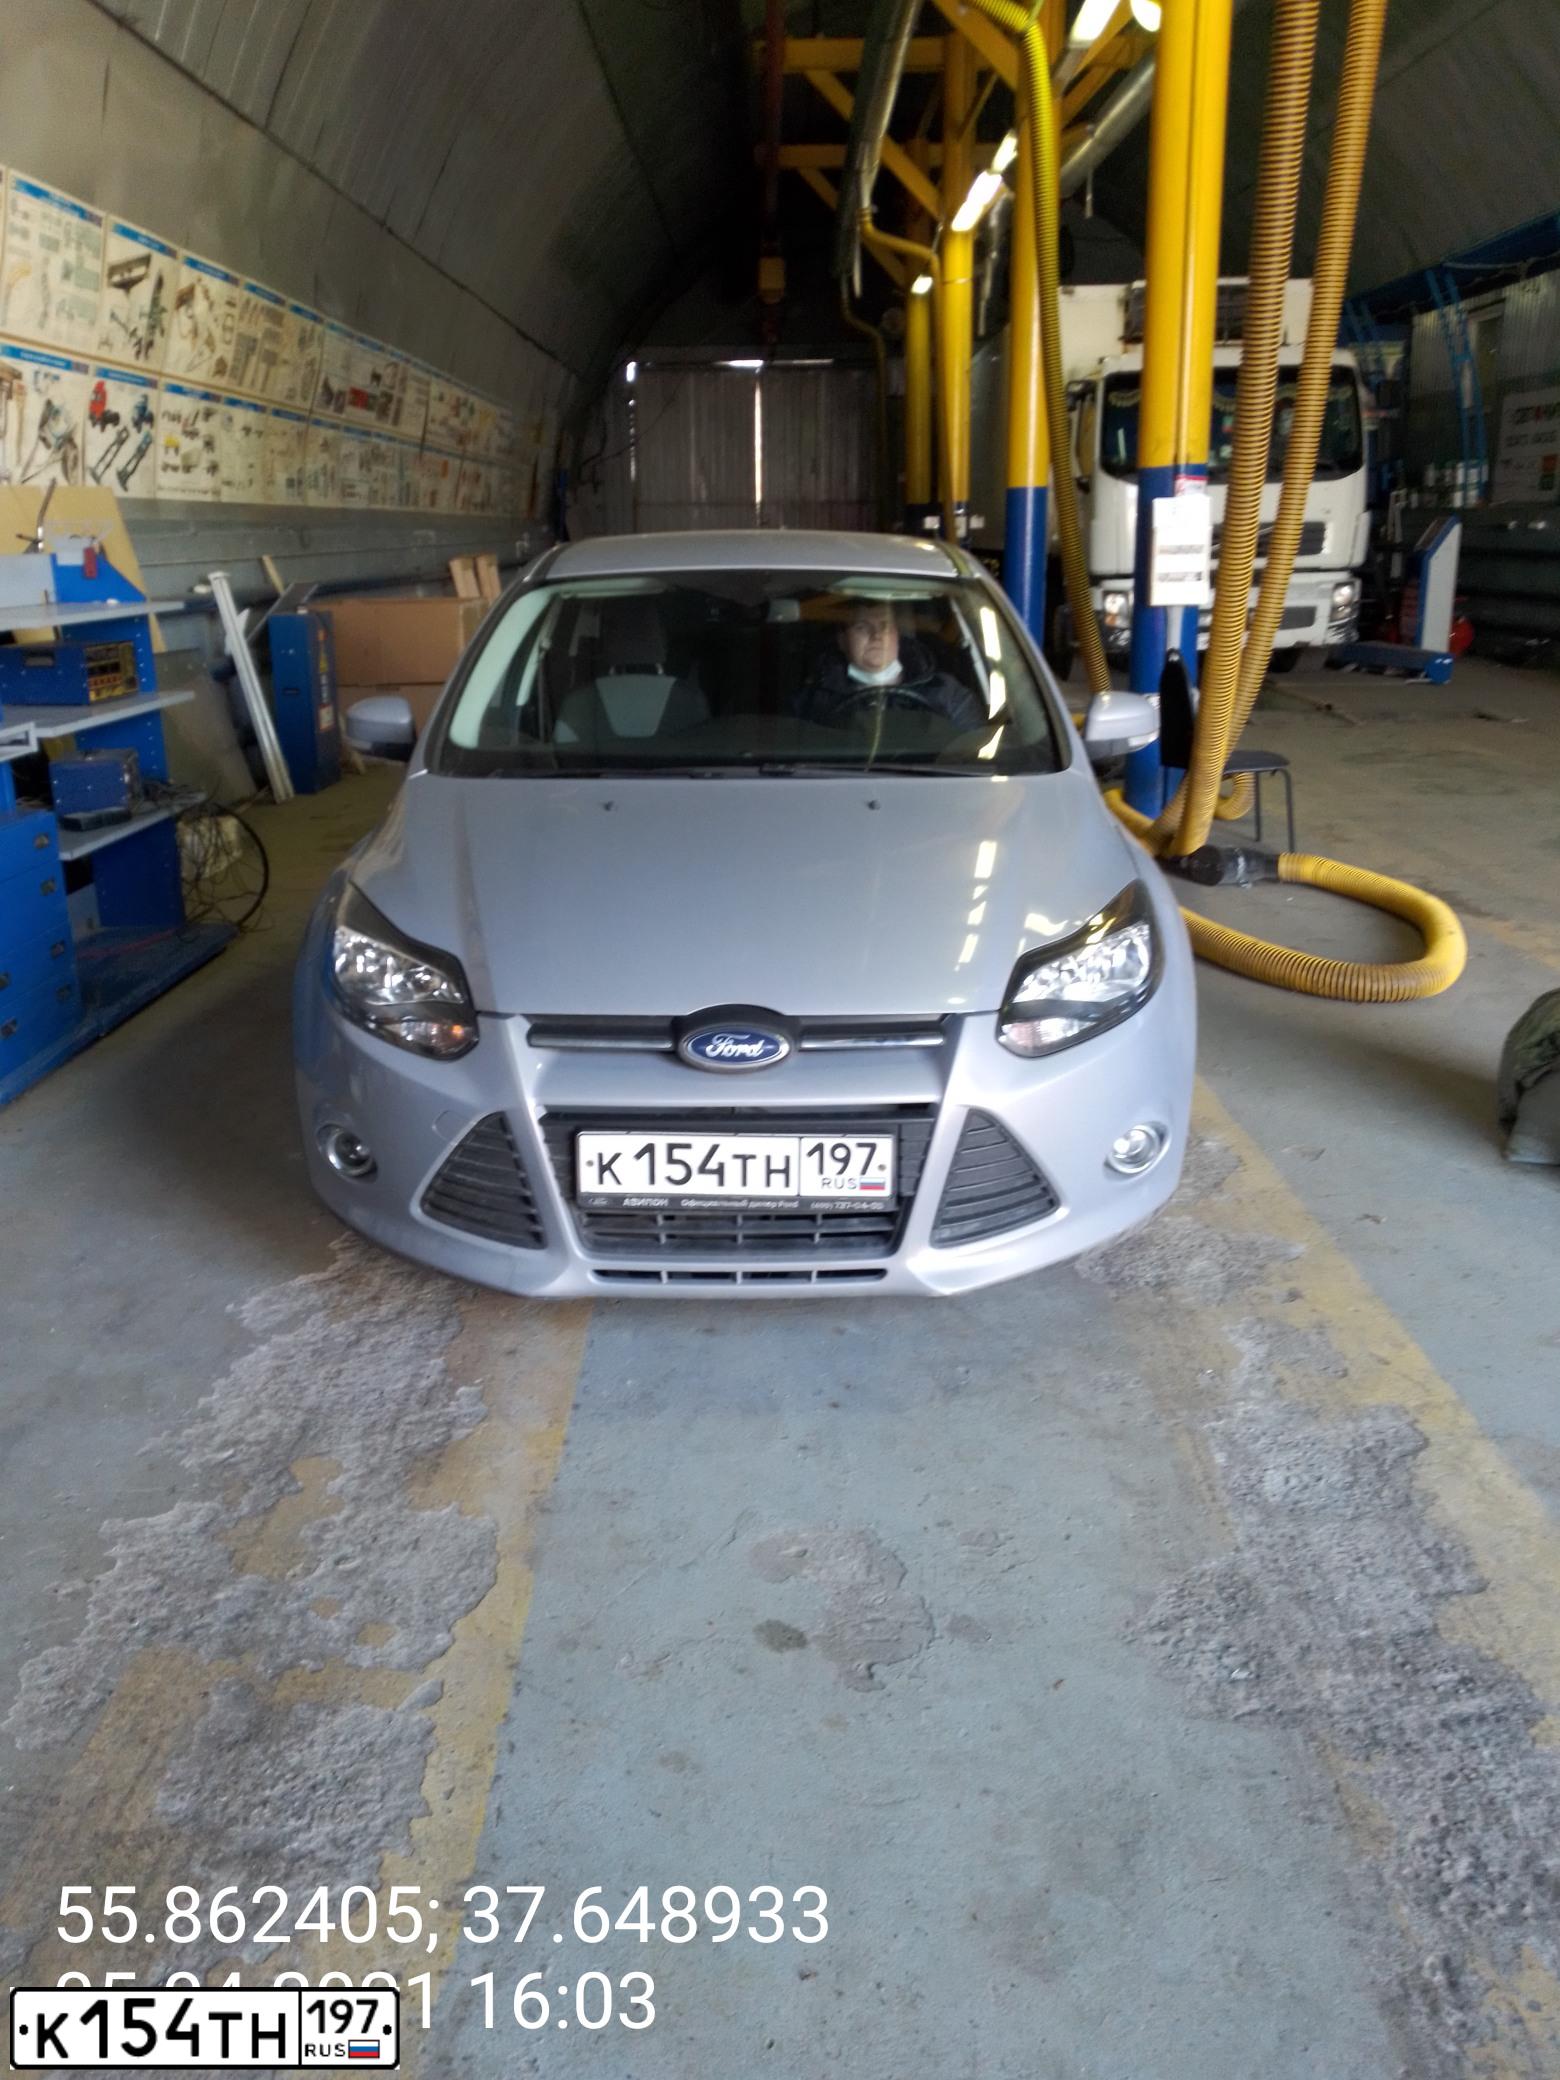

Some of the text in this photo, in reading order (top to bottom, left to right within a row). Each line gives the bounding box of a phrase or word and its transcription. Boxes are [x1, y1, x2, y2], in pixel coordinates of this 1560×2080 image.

[705, 1033, 765, 1058] Ford
[806, 1142, 877, 1176] 197
[821, 1177, 857, 1190] RUS
